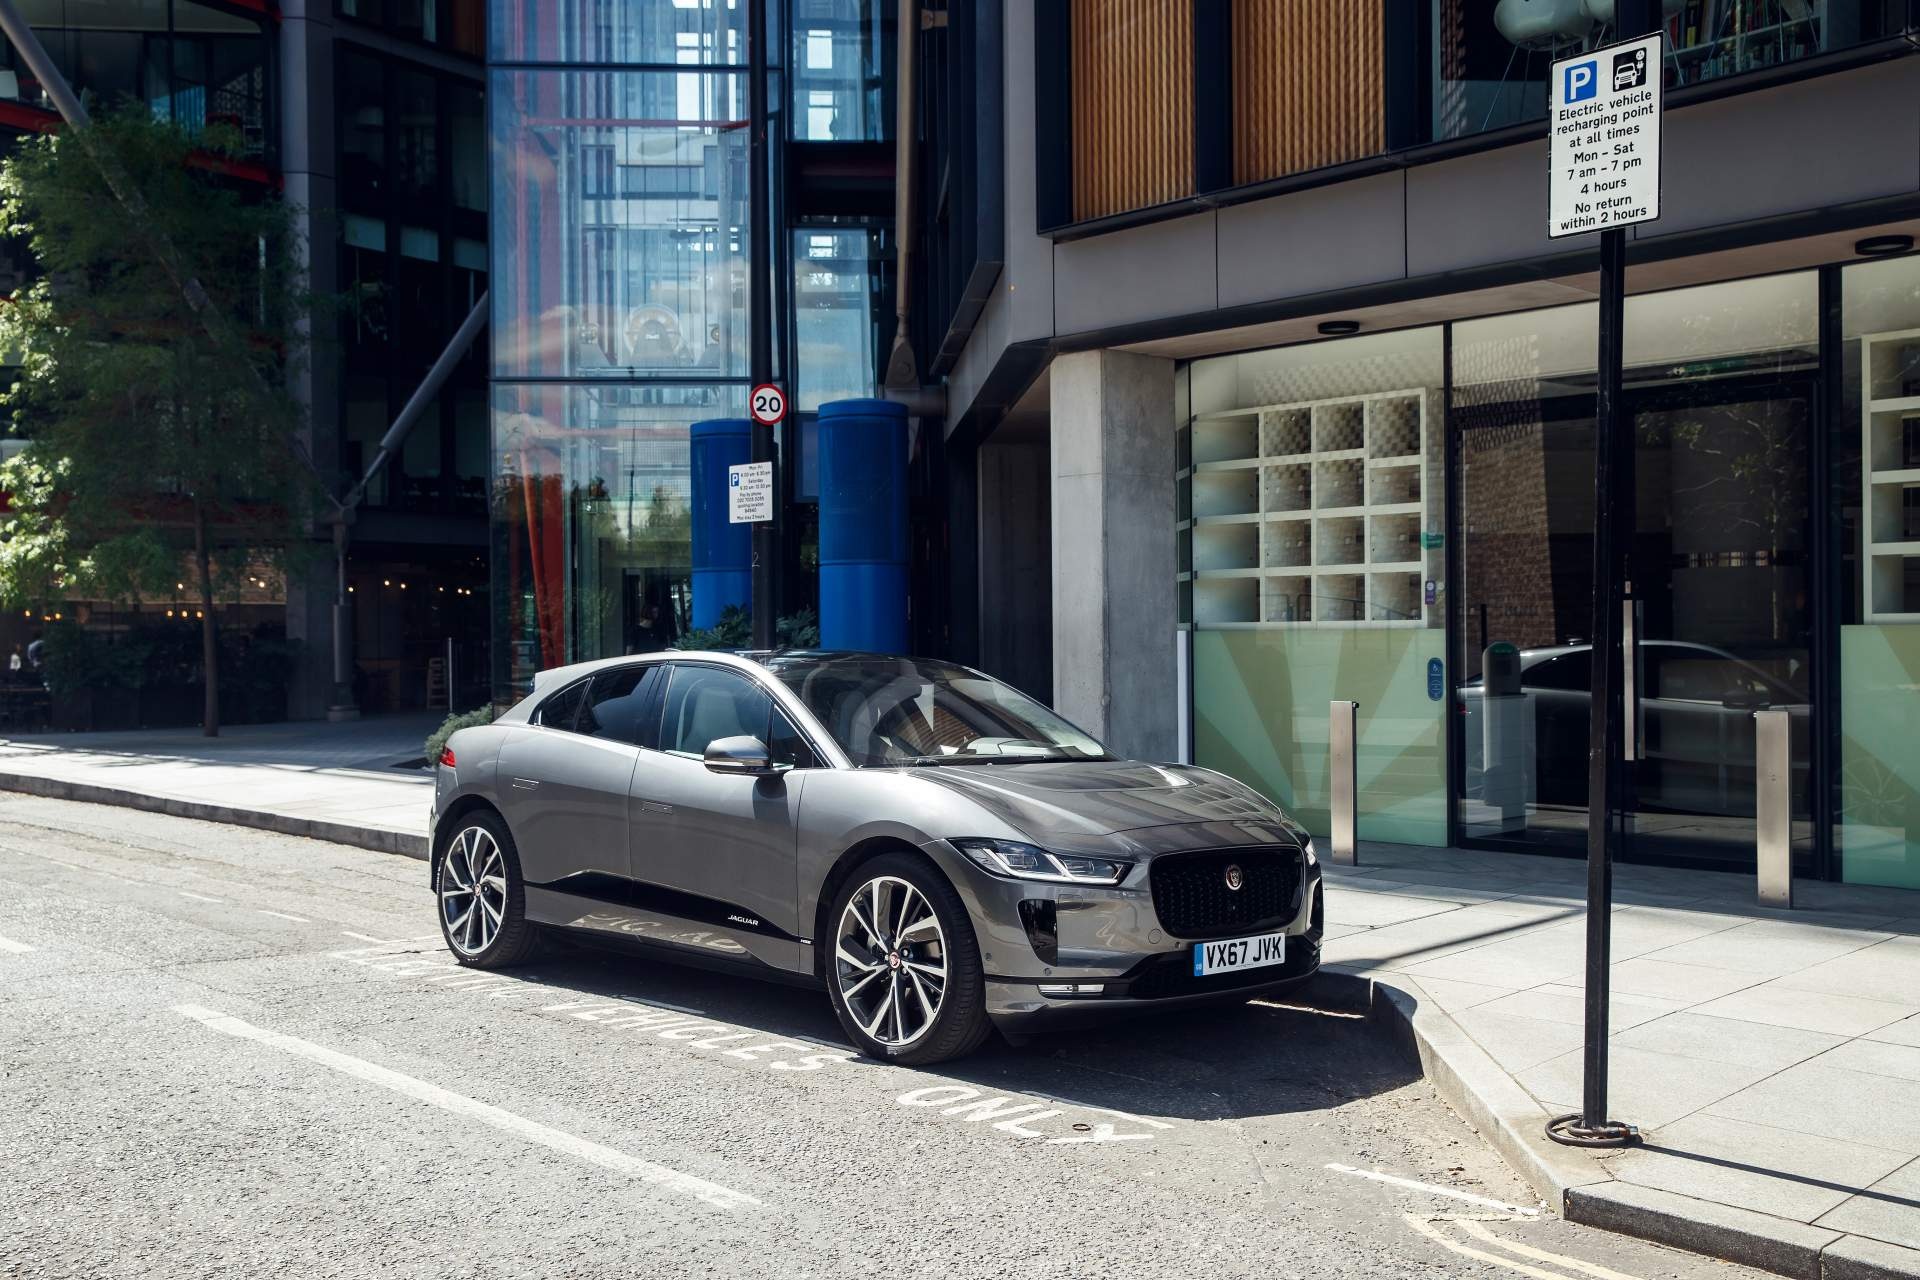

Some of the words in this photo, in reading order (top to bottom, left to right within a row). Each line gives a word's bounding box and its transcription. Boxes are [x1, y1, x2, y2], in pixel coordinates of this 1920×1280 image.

[1570, 66, 1592, 100] P
[1559, 101, 1604, 121] Electric
[1609, 90, 1652, 109] vehicle
[1556, 113, 1618, 136] recharging
[1622, 102, 1654, 122] point
[1569, 135, 1582, 148] at
[1586, 131, 1602, 145] all
[1606, 124, 1640, 141] times
[1574, 151, 1598, 165] Mon
[1613, 141, 1635, 156] Sat
[1567, 169, 1575, 180] 7
[1579, 167, 1596, 178] am
[1611, 160, 1618, 172] 7
[1623, 157, 1642, 174] pm
[1580, 183, 1589, 195] 4
[1593, 177, 1627, 193] hours
[1575, 202, 1591, 215] No
[1596, 195, 1632, 211] return
[1560, 215, 1596, 231] within
[1600, 212, 1608, 224] 2
[1613, 206, 1647, 222] hours
[755, 395, 781, 413] 20
[732, 474, 738, 486] P
[727, 914, 759, 926] JAGUAR
[1206, 940, 1248, 969] VX67
[1252, 936, 1282, 962] JVK
[541, 1000, 850, 1071] VEHICLES
[896, 1085, 1155, 1143] ONLY
